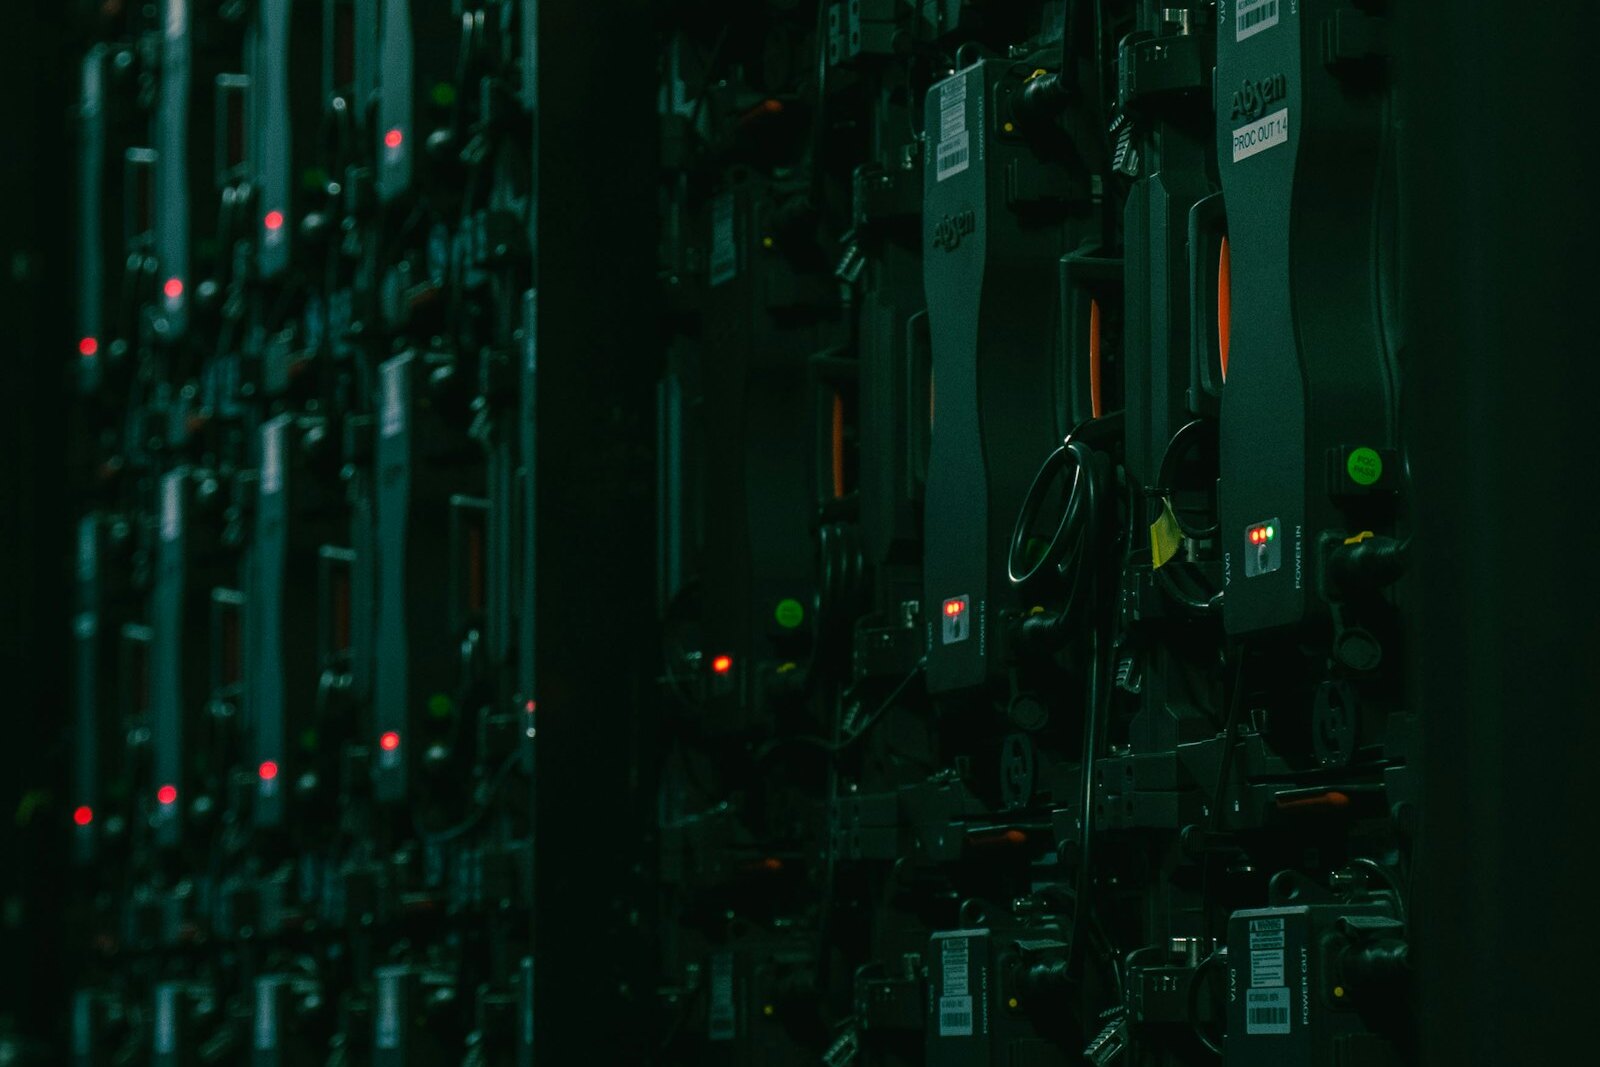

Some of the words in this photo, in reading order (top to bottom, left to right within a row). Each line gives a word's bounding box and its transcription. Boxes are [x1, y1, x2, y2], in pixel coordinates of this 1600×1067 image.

[1234, 129, 1256, 151] PROC
[1258, 120, 1275, 142] OUT
[1295, 525, 1302, 538] IN
[1301, 976, 1309, 1025] POWER
